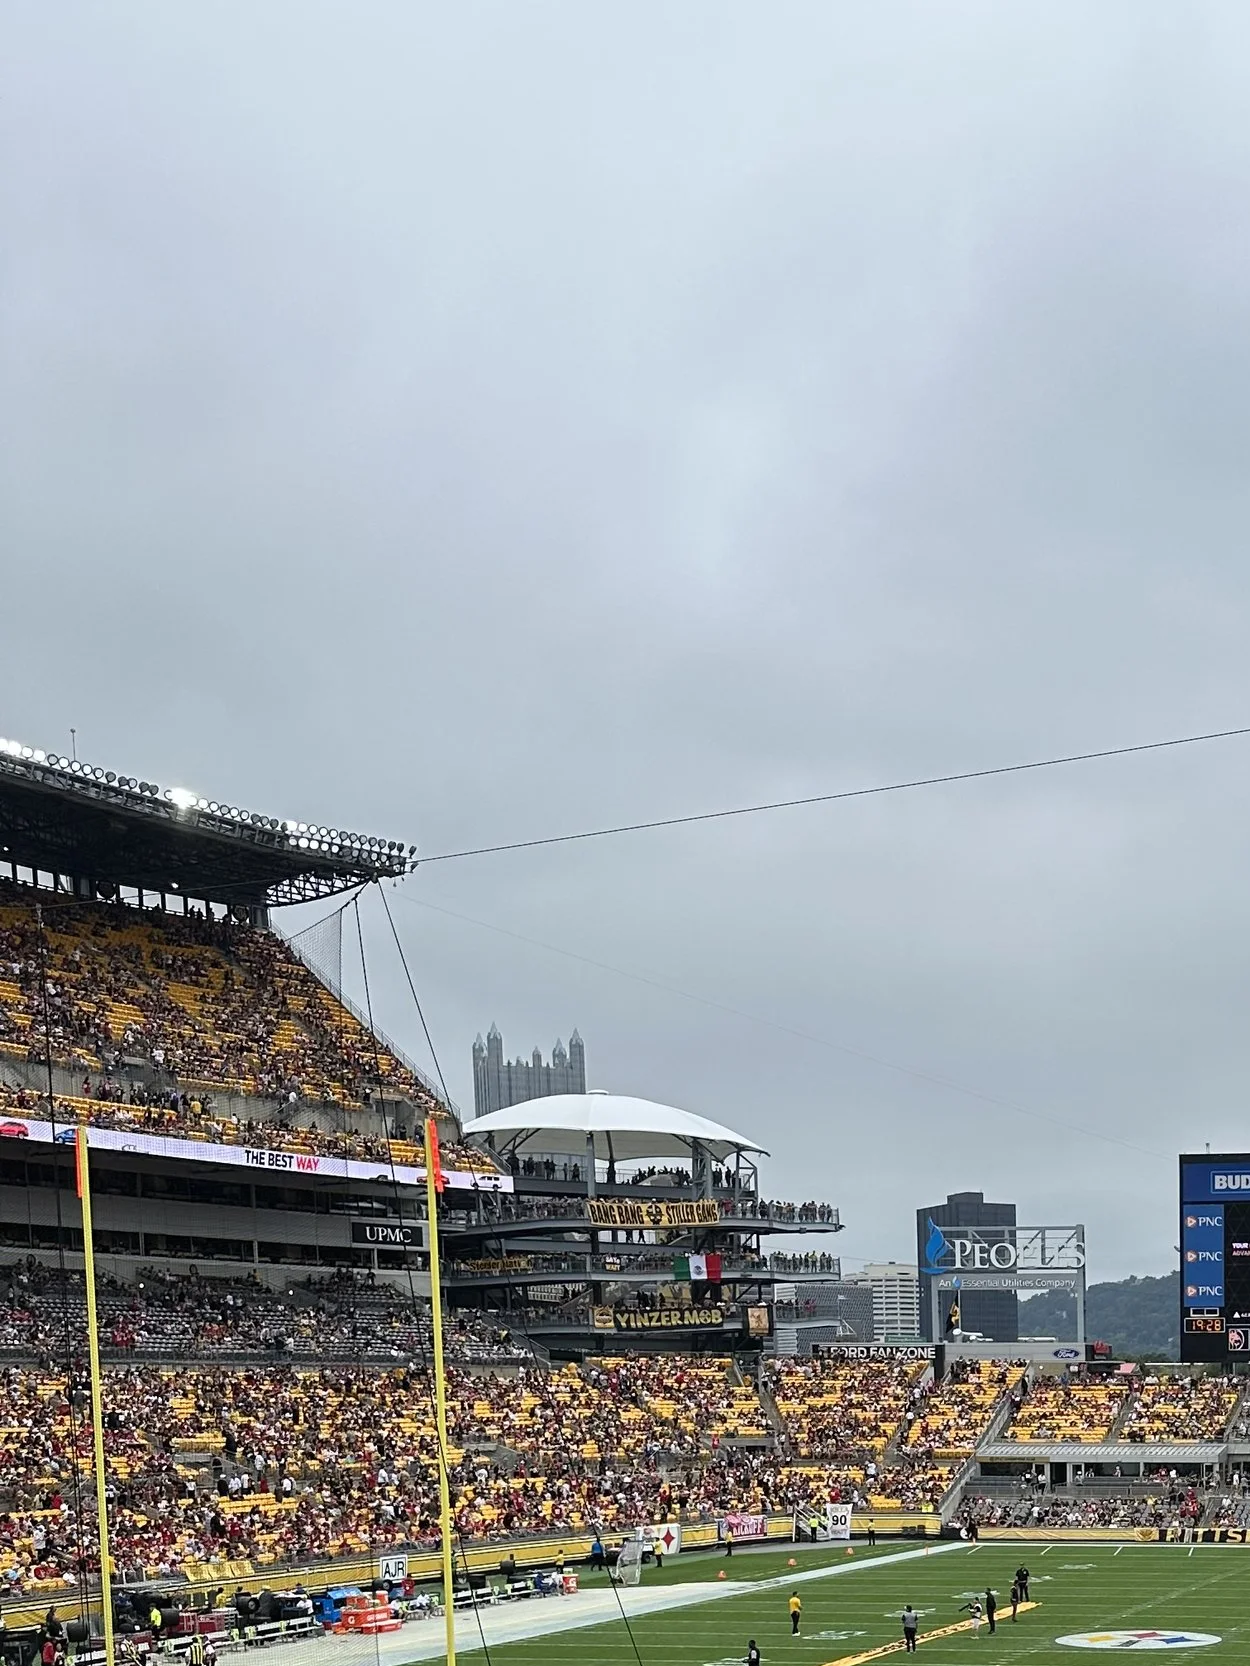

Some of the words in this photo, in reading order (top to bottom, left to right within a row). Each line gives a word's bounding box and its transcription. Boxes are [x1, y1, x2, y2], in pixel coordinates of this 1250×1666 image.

[245, 1149, 265, 1166] THE
[267, 1152, 294, 1169] BEST
[296, 1155, 320, 1172] WAY
[589, 1203, 617, 1224] BANG
[615, 1204, 644, 1225] BANG
[665, 1203, 695, 1225] STILLER
[695, 1202, 718, 1222] GANG
[1198, 1216, 1223, 1227] PNC
[365, 1225, 412, 1244] UPMC
[952, 1239, 1086, 1269] PEOPLES
[1198, 1251, 1223, 1262] PNC
[938, 1279, 951, 1287] An
[961, 1279, 999, 1287] Essential
[1001, 1278, 1034, 1287] Utilities
[1035, 1278, 1076, 1289] Company
[1198, 1285, 1223, 1296] PNC
[615, 1309, 683, 1329] YINZER
[684, 1309, 723, 1325] MOB
[898, 1347, 936, 1359] ZONE
[831, 1514, 847, 1526] 90
[383, 1561, 405, 1578] AJR
